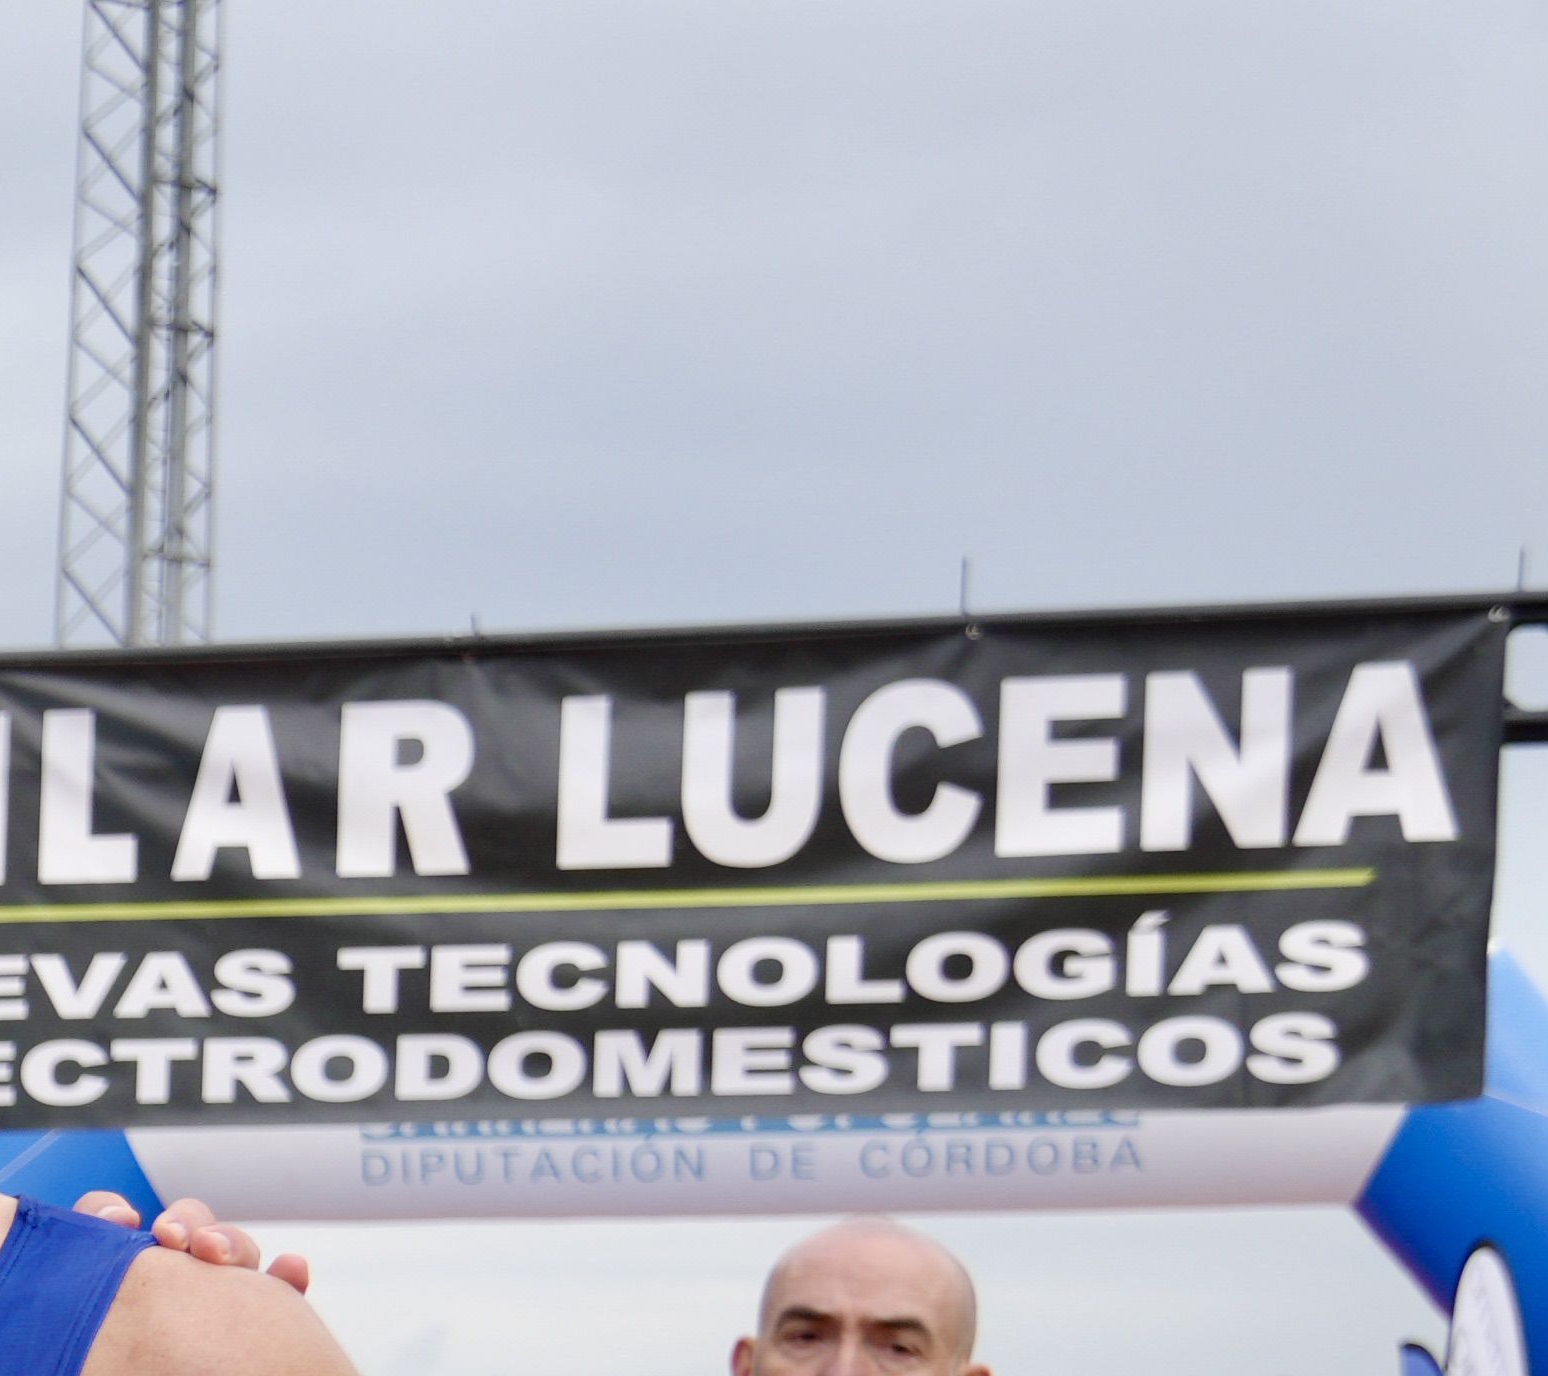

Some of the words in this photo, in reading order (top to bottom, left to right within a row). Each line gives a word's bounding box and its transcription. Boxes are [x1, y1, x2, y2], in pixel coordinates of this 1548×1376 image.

[556, 660, 1461, 869] LUCENA
[336, 912, 1370, 1013] TECNOLOGÍAS
[360, 1131, 707, 1186] DIPUTACIÓN
[754, 1142, 818, 1182] DE
[883, 1128, 1145, 1180] CÓRDOBA
